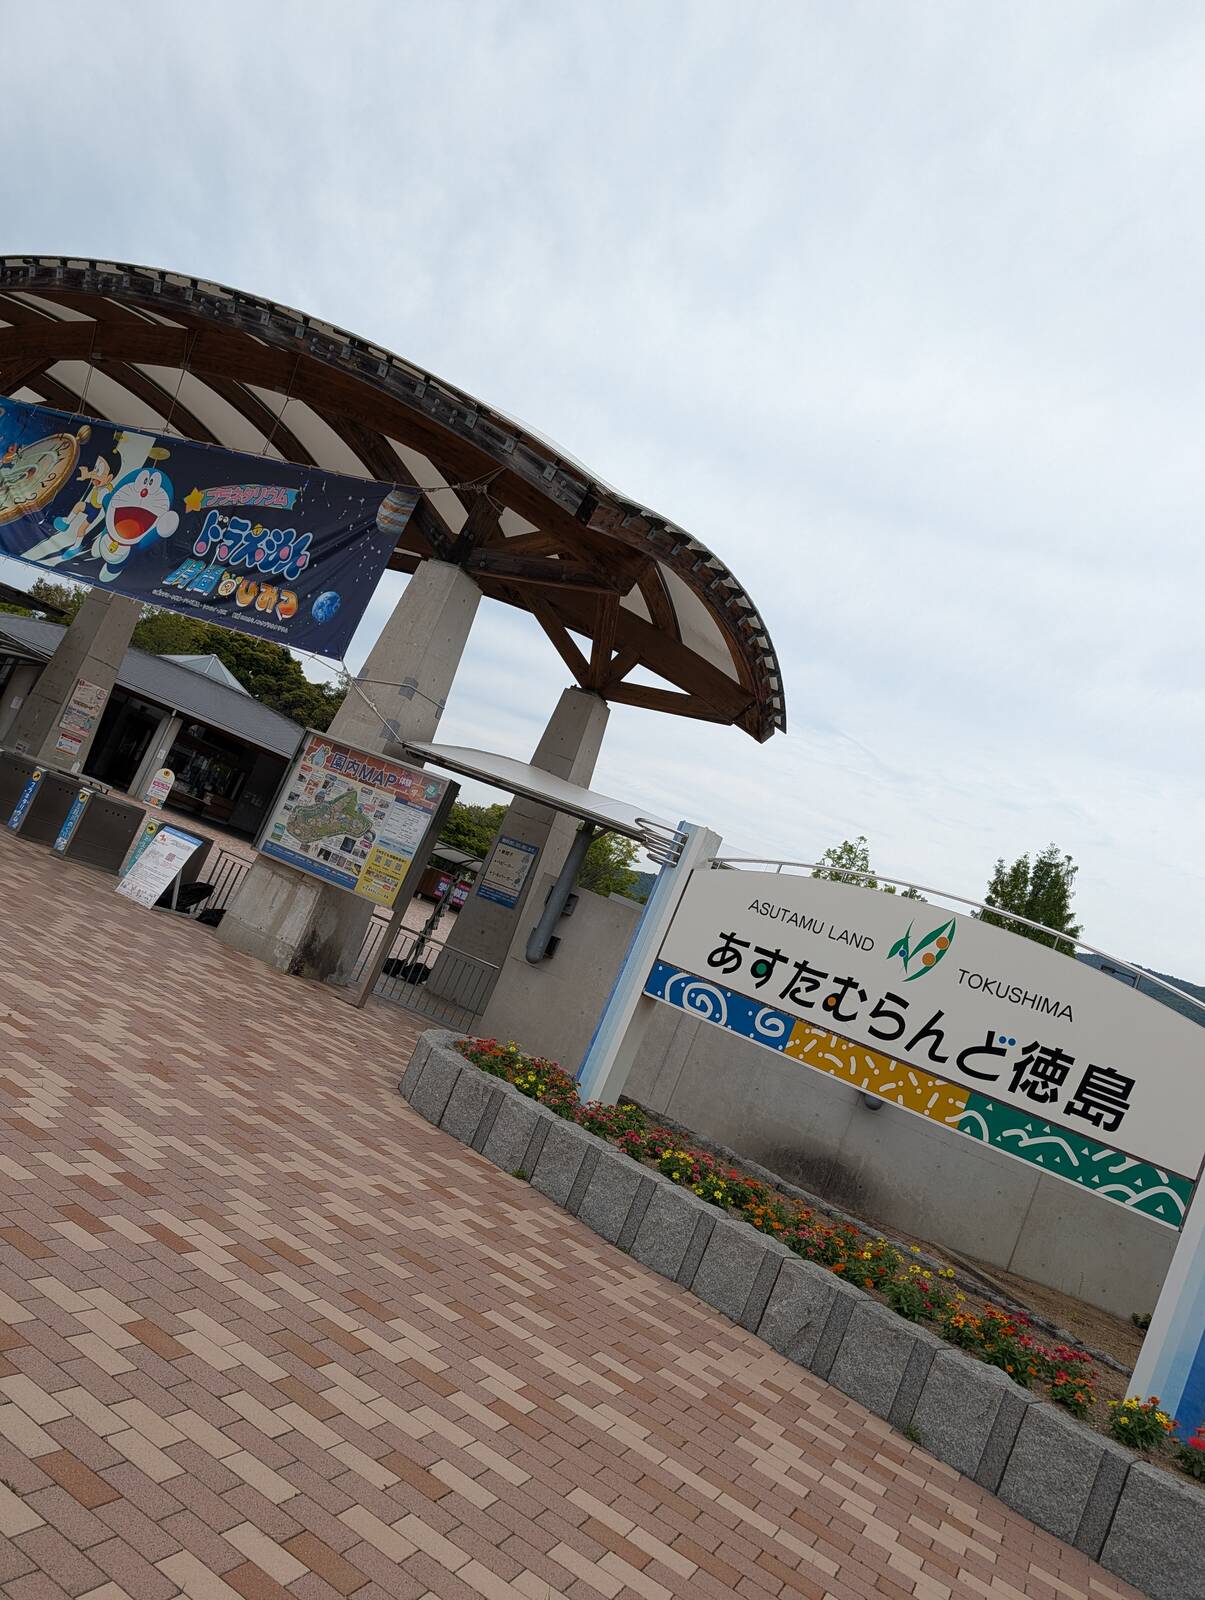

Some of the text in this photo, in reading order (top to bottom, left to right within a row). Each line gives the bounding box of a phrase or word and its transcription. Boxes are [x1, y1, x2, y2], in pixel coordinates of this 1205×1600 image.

[207, 487, 288, 506] プラネタリウム
[193, 510, 313, 580] ドラえもん
[331, 753, 398, 787] 園内MAP
[748, 899, 875, 952] ASUTAMU LAND
[957, 968, 1074, 1022] TOKUSHIMA
[707, 932, 1136, 1132] あすたむらんど徳島
